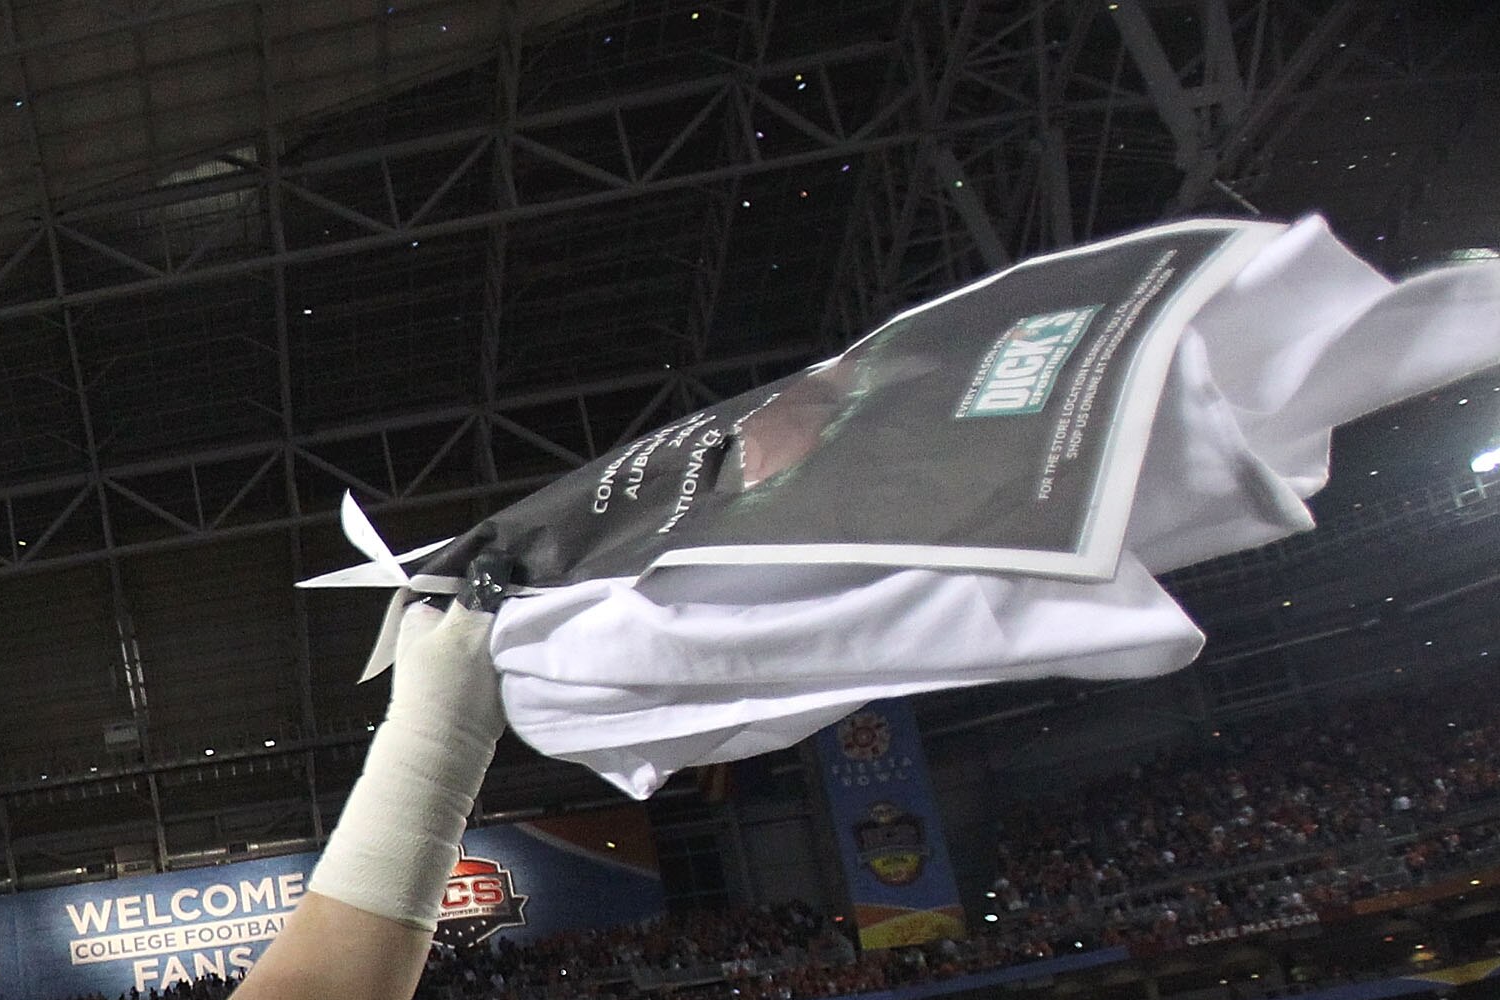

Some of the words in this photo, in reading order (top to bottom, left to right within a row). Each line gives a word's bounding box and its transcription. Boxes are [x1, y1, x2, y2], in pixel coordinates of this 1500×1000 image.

[1062, 367, 1090, 417] LOCATION
[1051, 417, 1071, 453] STORE
[1066, 428, 1085, 459] SHOP
[1077, 410, 1091, 429] US
[1046, 452, 1061, 477] THE
[1038, 475, 1055, 500] FOR
[66, 873, 305, 936] WELCOME
[441, 878, 505, 910] CS
[75, 931, 178, 960] COLLEGE
[133, 946, 255, 993] FANS
